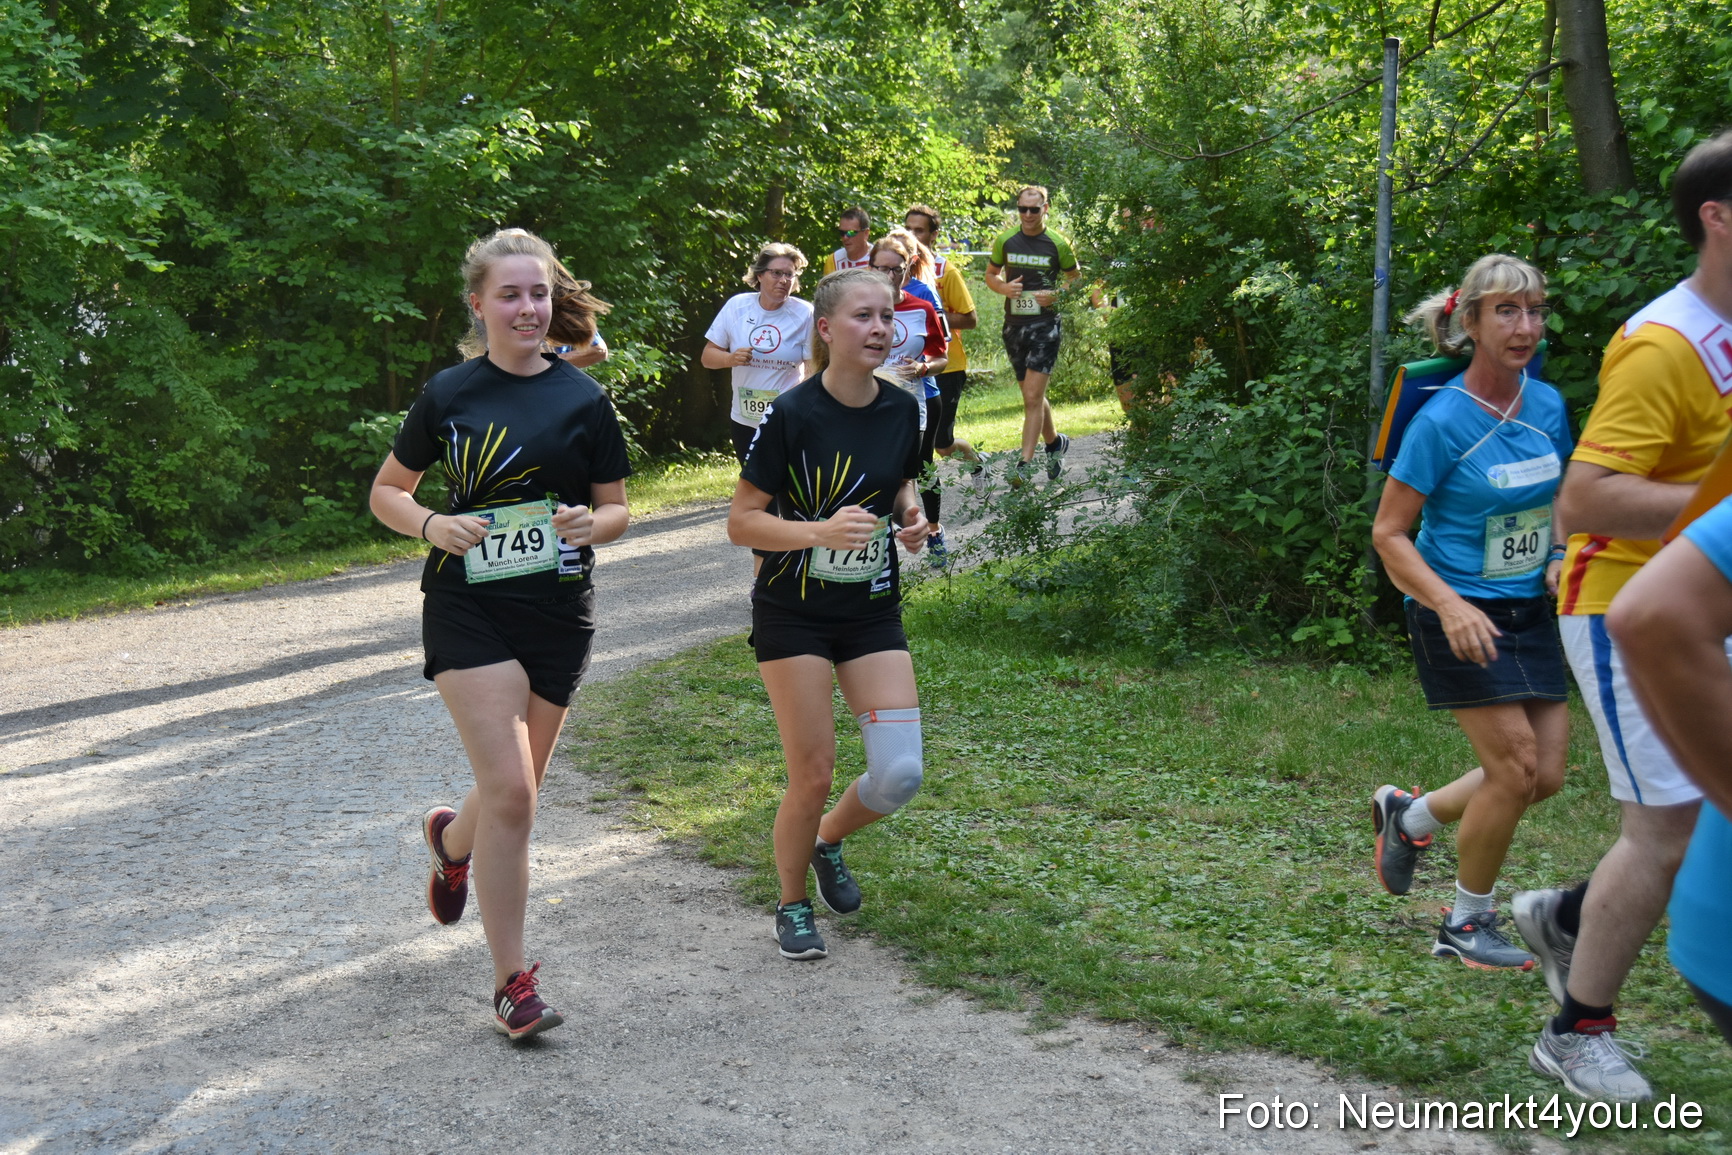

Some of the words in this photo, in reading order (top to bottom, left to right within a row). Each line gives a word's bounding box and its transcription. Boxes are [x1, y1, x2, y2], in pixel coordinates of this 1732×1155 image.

[1007, 252, 1051, 267] BOCK
[1016, 299, 1034, 309] 333
[475, 527, 545, 562] 1749
[1502, 531, 1539, 560] 840
[487, 558, 513, 569] Münch
[513, 554, 539, 565] Lorena
